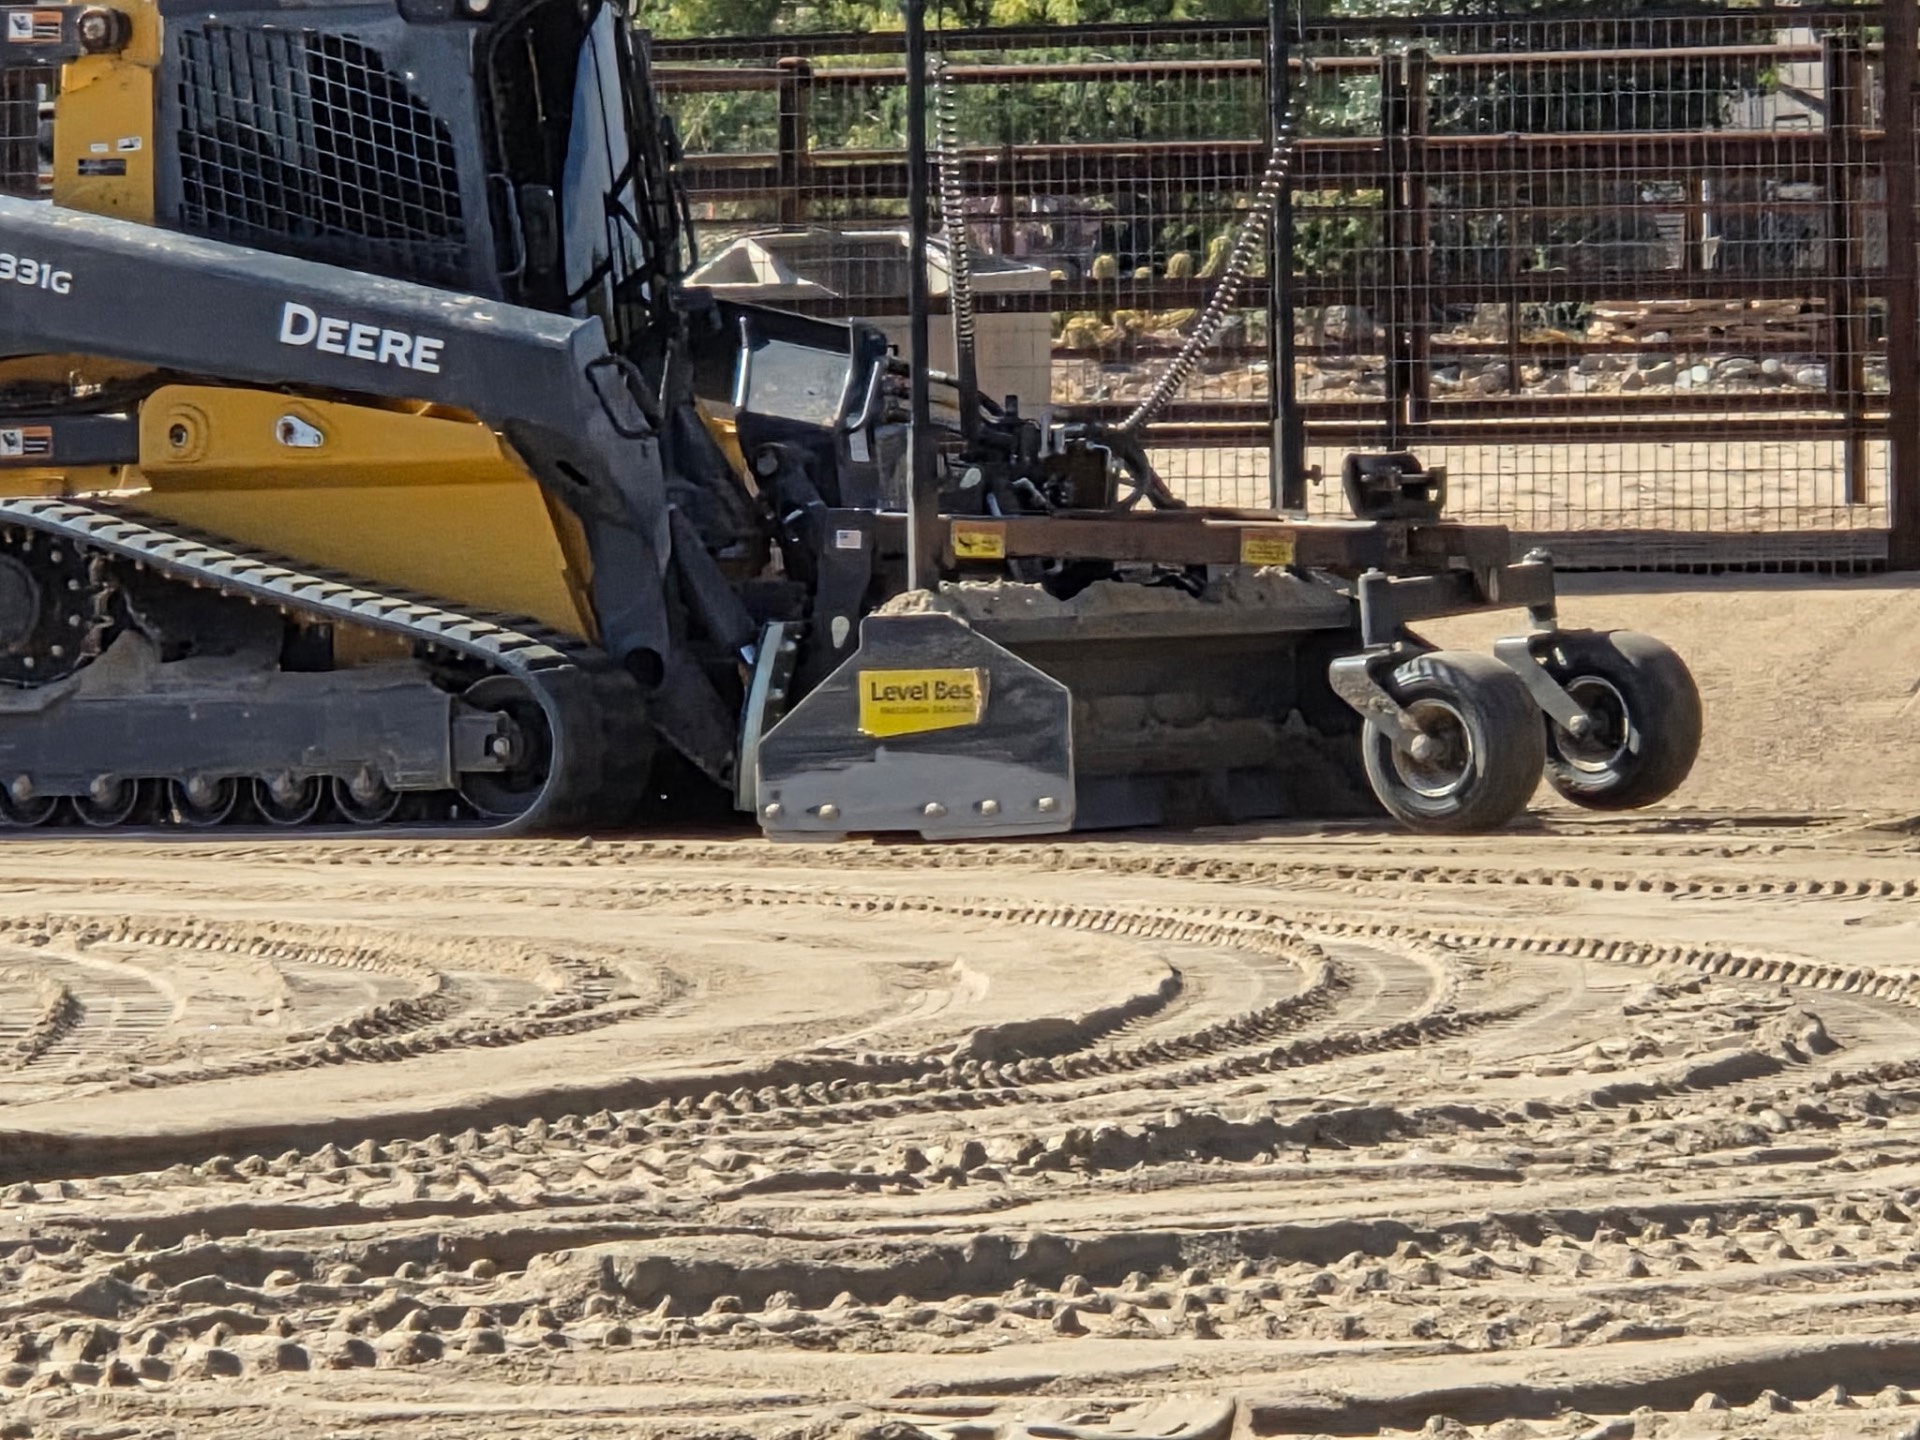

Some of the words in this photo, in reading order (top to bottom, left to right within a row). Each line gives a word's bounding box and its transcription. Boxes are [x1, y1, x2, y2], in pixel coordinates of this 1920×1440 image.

[0, 253, 73, 294] 331G
[280, 301, 445, 373] DEERE
[871, 681, 929, 701] Level
